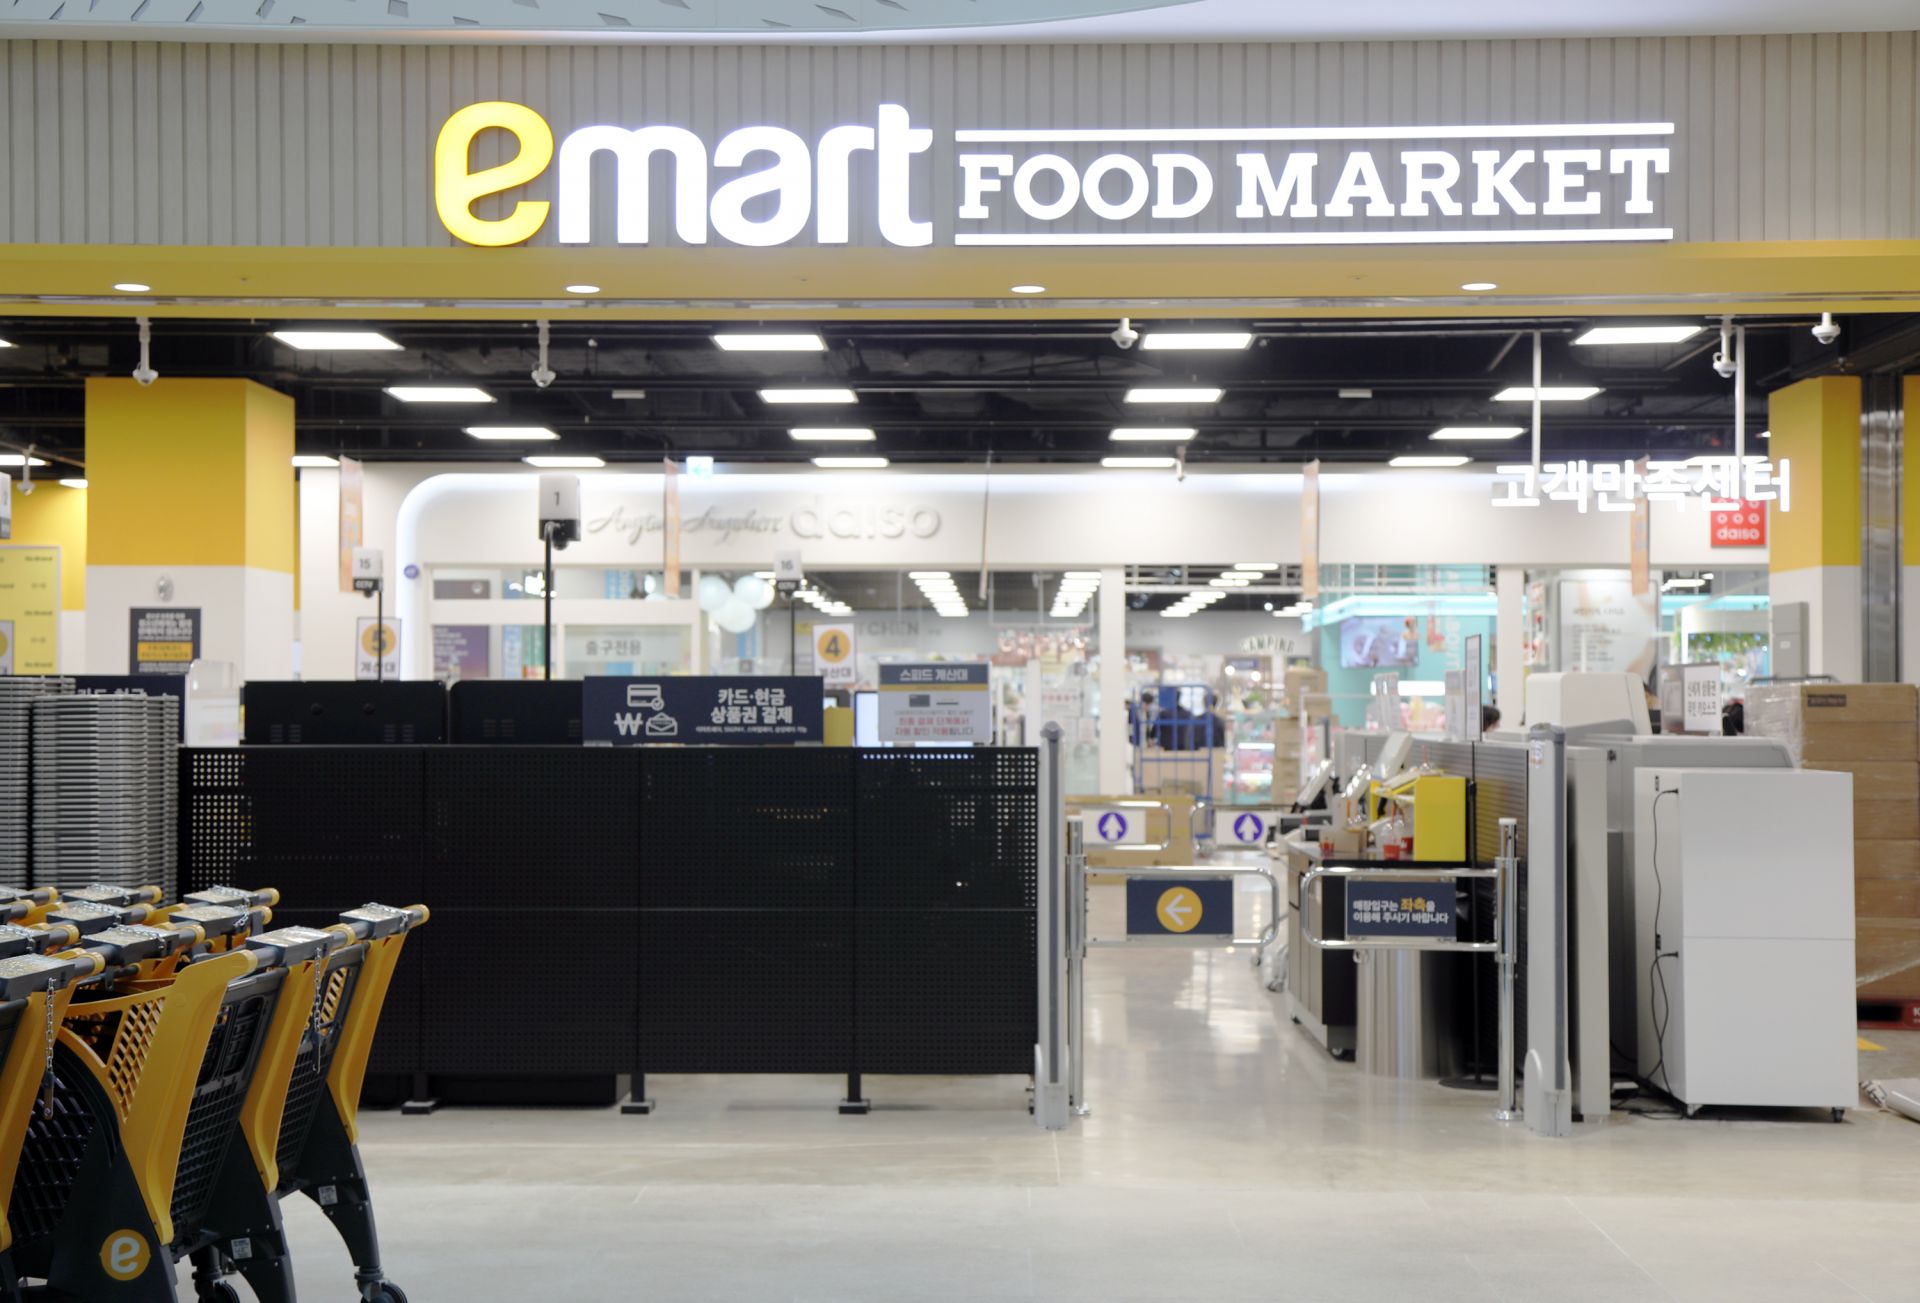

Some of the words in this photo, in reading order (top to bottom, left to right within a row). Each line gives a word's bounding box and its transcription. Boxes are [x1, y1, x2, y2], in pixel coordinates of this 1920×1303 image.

[435, 100, 933, 247] emart
[959, 153, 1214, 220] FOOD
[1236, 148, 1671, 218] MARKET
[790, 495, 942, 540] daiso
[1716, 526, 1760, 540] daiso
[371, 628, 387, 653] 5
[825, 635, 841, 657] 4
[900, 669, 933, 681] 스피드
[710, 706, 758, 724] 상품권
[761, 706, 794, 724] 결제
[1353, 912, 1381, 924] 이용해
[1382, 912, 1411, 924] 주시기
[1411, 912, 1449, 924] 바랍니다
[110, 1236, 141, 1275] e
